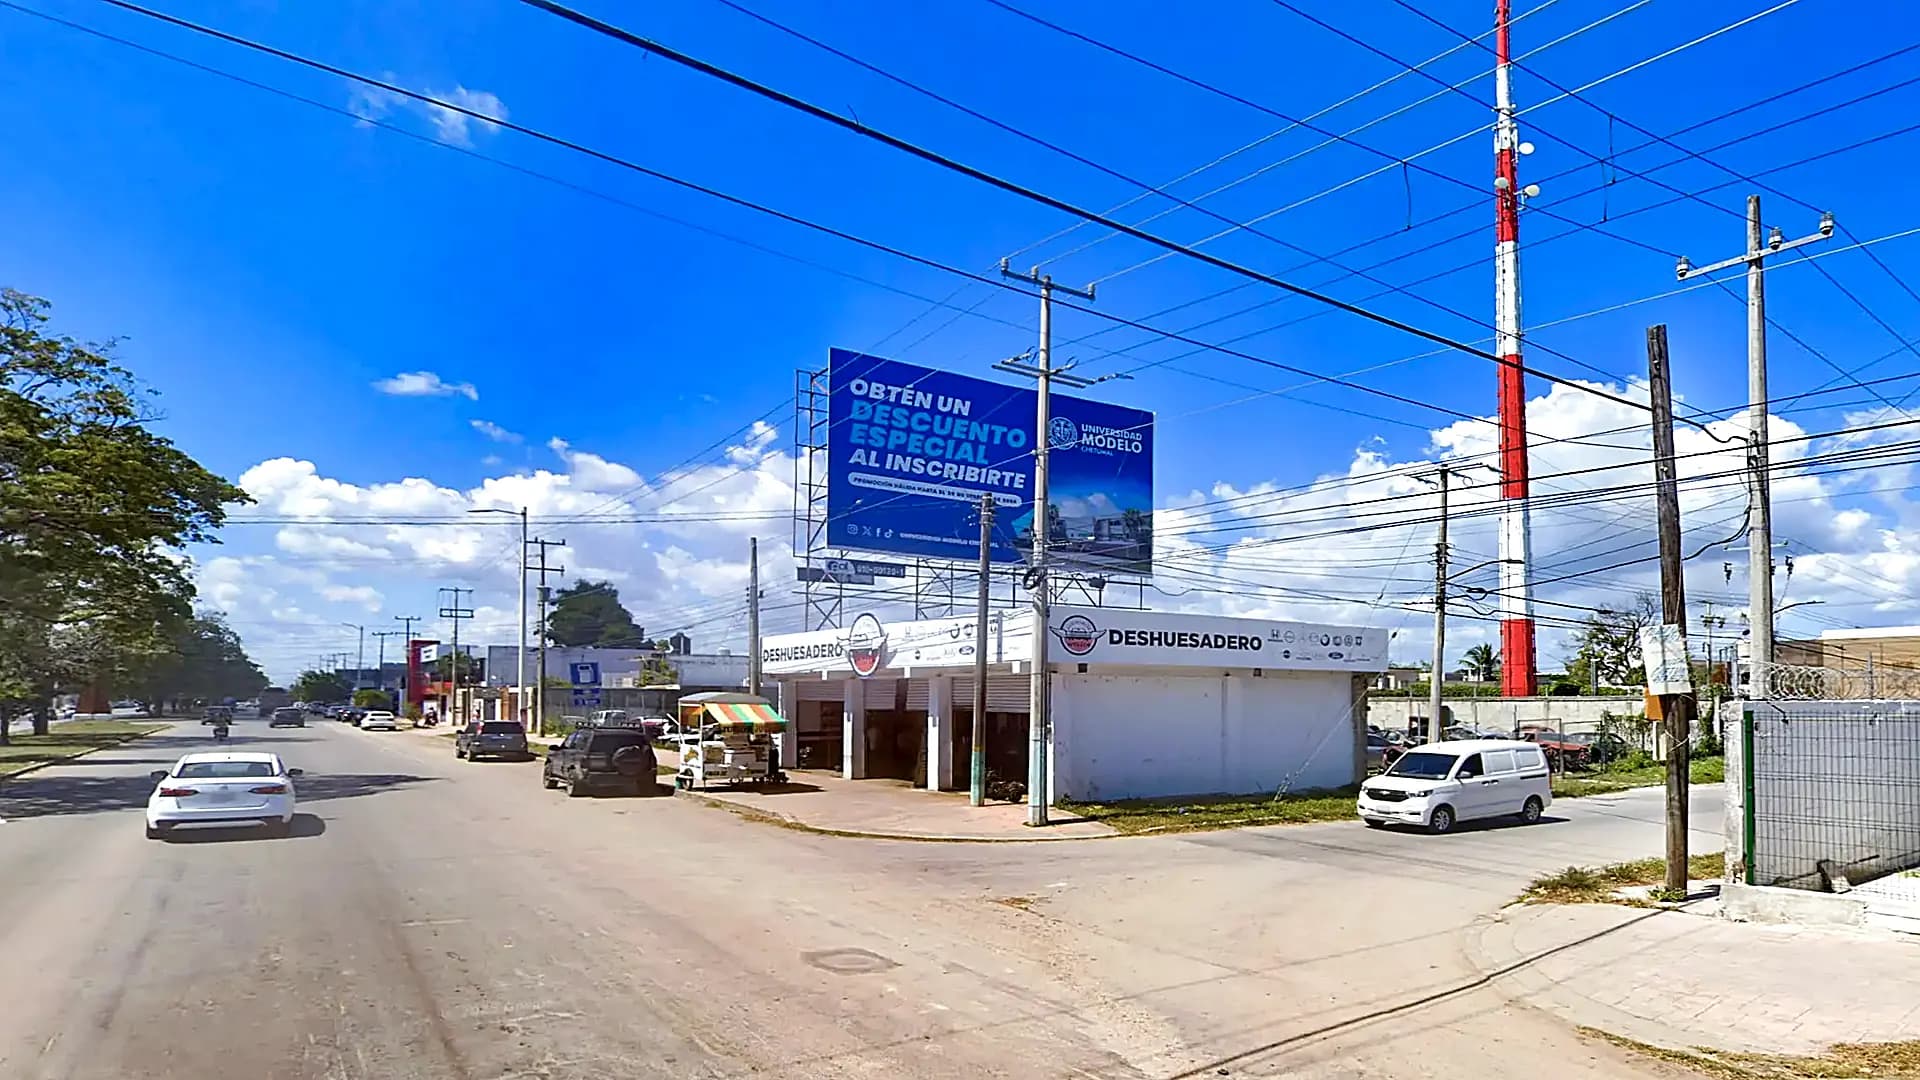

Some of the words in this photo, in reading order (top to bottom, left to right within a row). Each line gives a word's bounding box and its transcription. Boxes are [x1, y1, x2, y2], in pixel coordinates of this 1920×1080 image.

[850, 378, 933, 409] OBTÉN
[937, 395, 971, 416] UN
[850, 399, 1027, 448] DESCUENTO
[1081, 424, 1142, 441] UNIVERSIDAD
[850, 423, 988, 464] ESPECIAL
[1081, 433, 1142, 453] MODELO
[849, 448, 880, 468] AL
[885, 453, 1026, 488] INSCRIBIRTE
[763, 642, 843, 663] DESHUESADERO
[1109, 629, 1262, 651] DESHUESADERO
